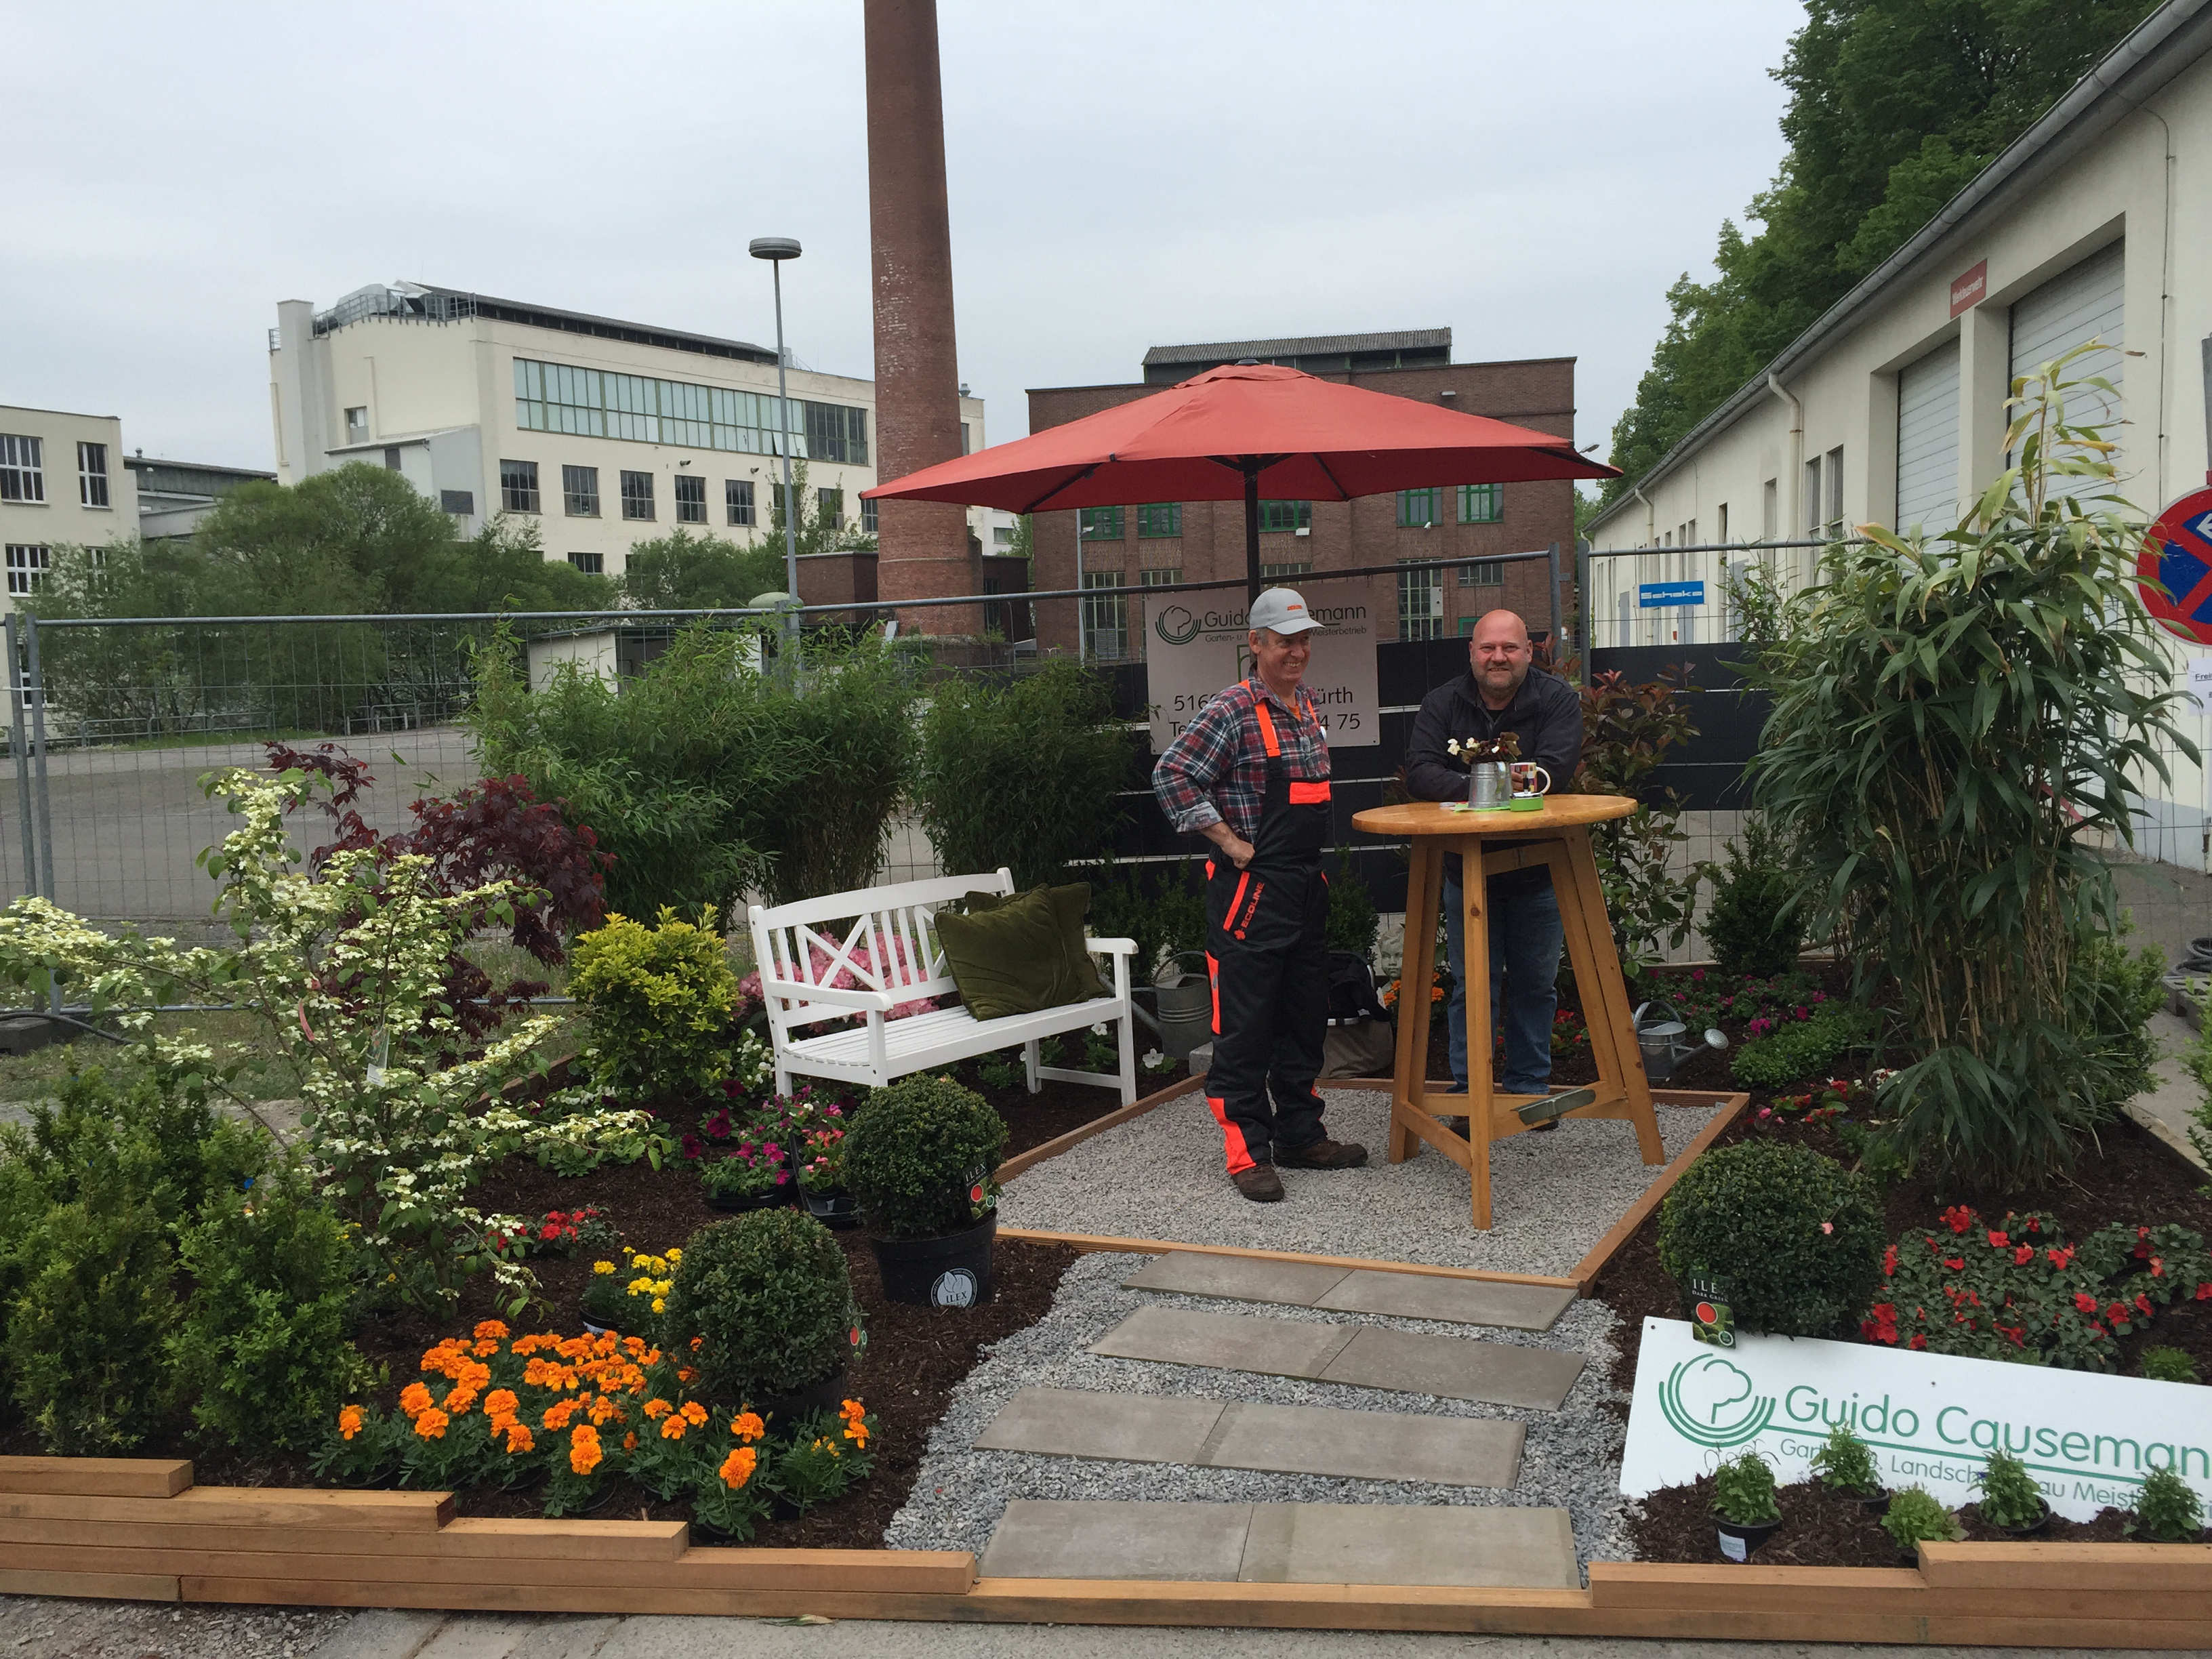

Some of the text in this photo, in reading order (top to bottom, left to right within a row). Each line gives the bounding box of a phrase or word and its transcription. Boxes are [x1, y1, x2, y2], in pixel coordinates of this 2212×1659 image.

[1309, 606, 1367, 621] emann
[1174, 693, 1217, 711] 516
[1169, 720, 1191, 737] Te
[1336, 713, 1360, 730] 75
[1241, 882, 1265, 928] ECOLINE
[946, 1291, 967, 1303] ILEX
[1692, 1290, 1707, 1298] DARK
[1785, 1385, 1919, 1437] Guido
